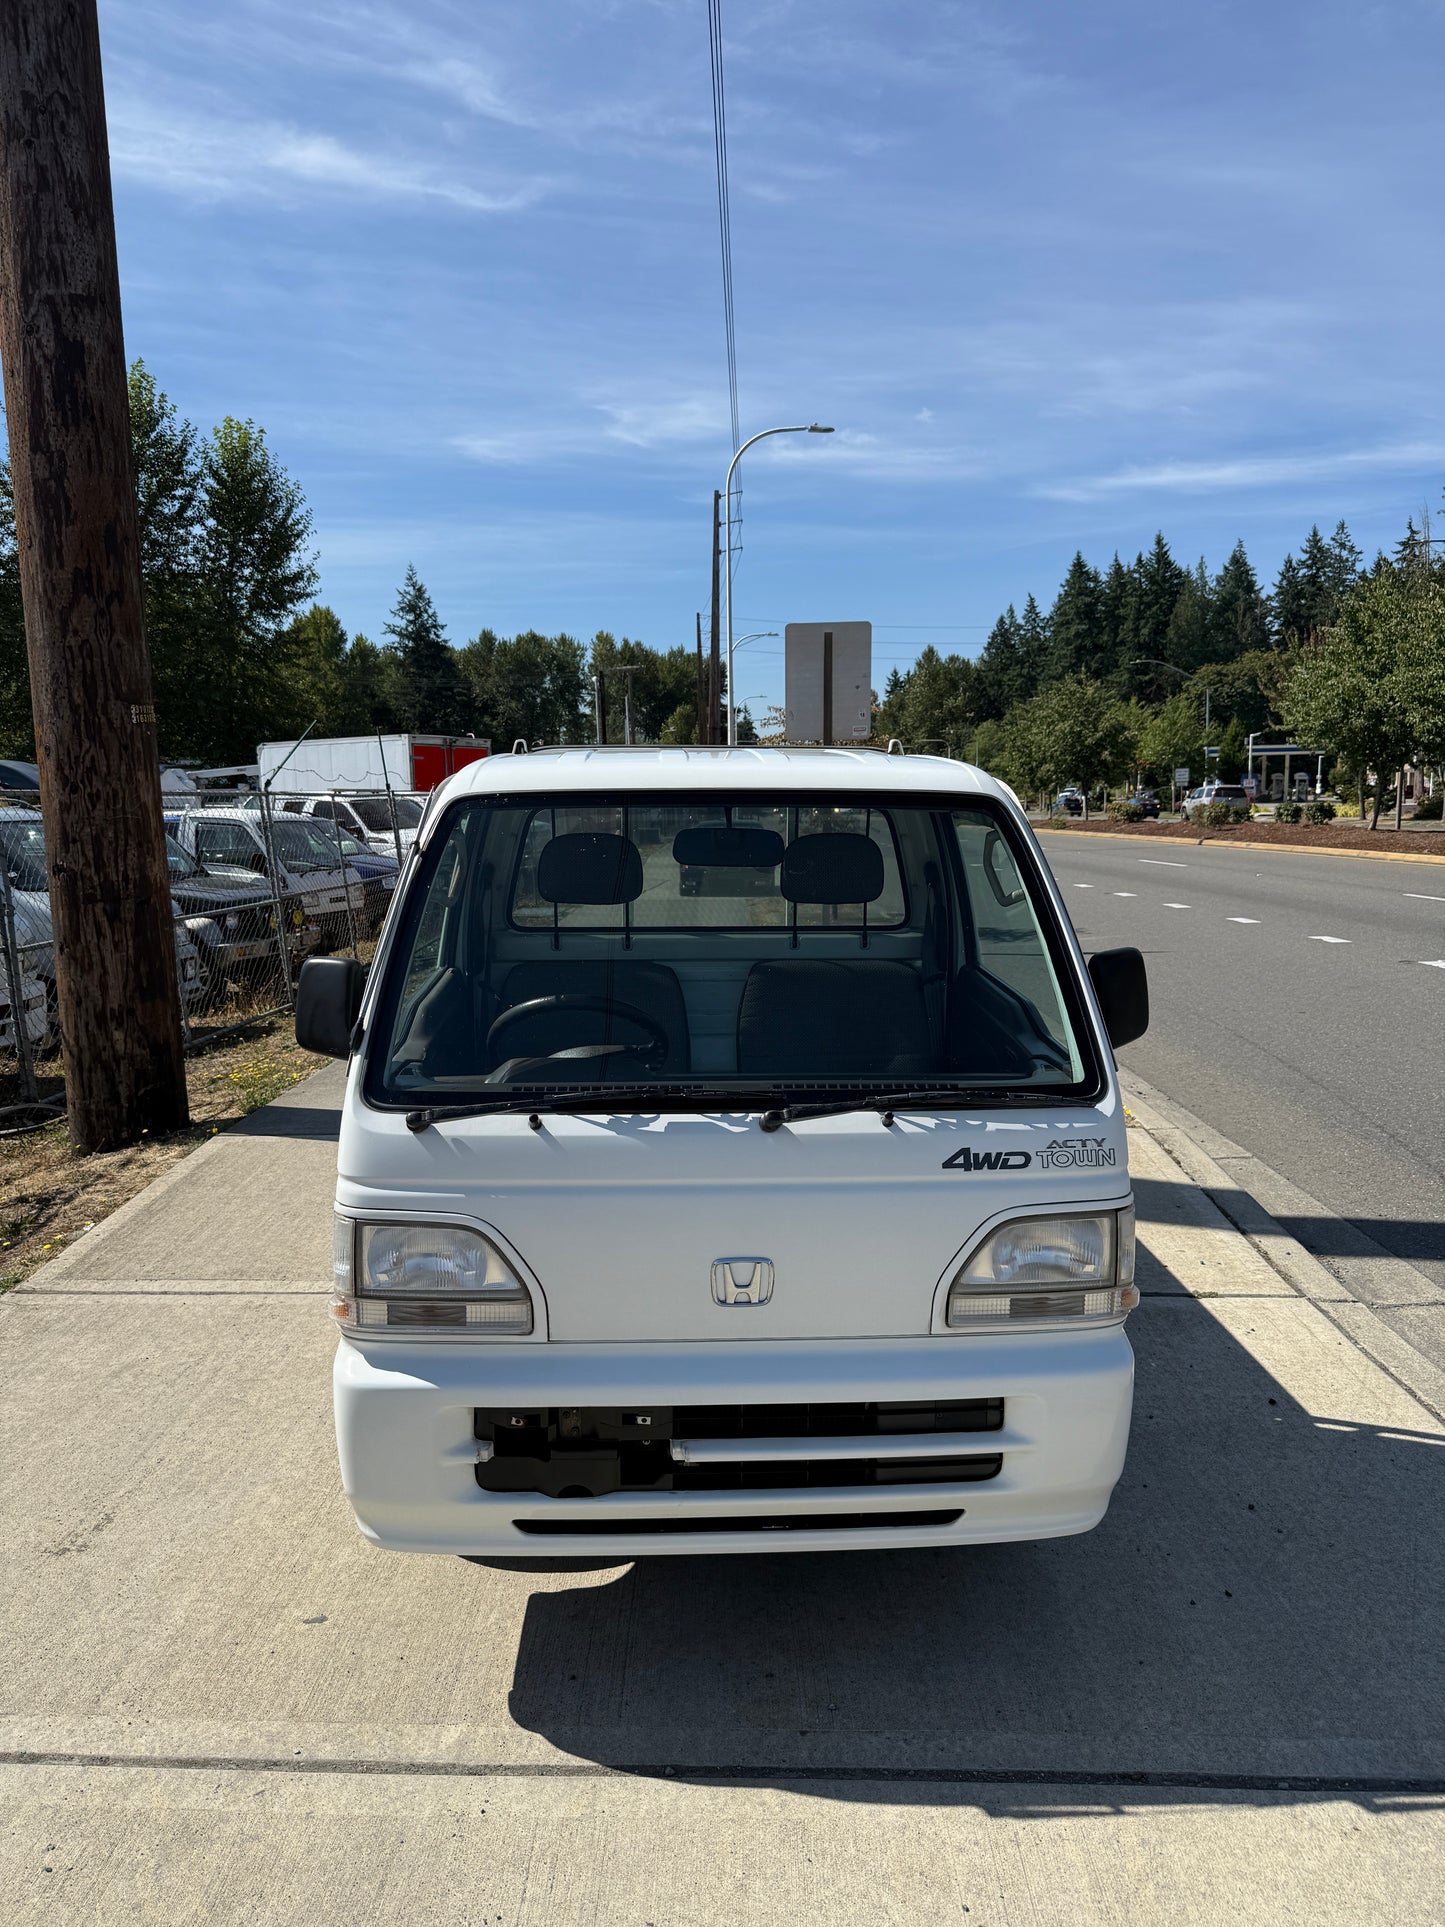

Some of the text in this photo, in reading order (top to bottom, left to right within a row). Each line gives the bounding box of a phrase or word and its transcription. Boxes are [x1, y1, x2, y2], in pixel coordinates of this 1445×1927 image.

[1046, 1137, 1107, 1149] ACTY
[941, 1147, 1116, 1172] 4WD TOWN
